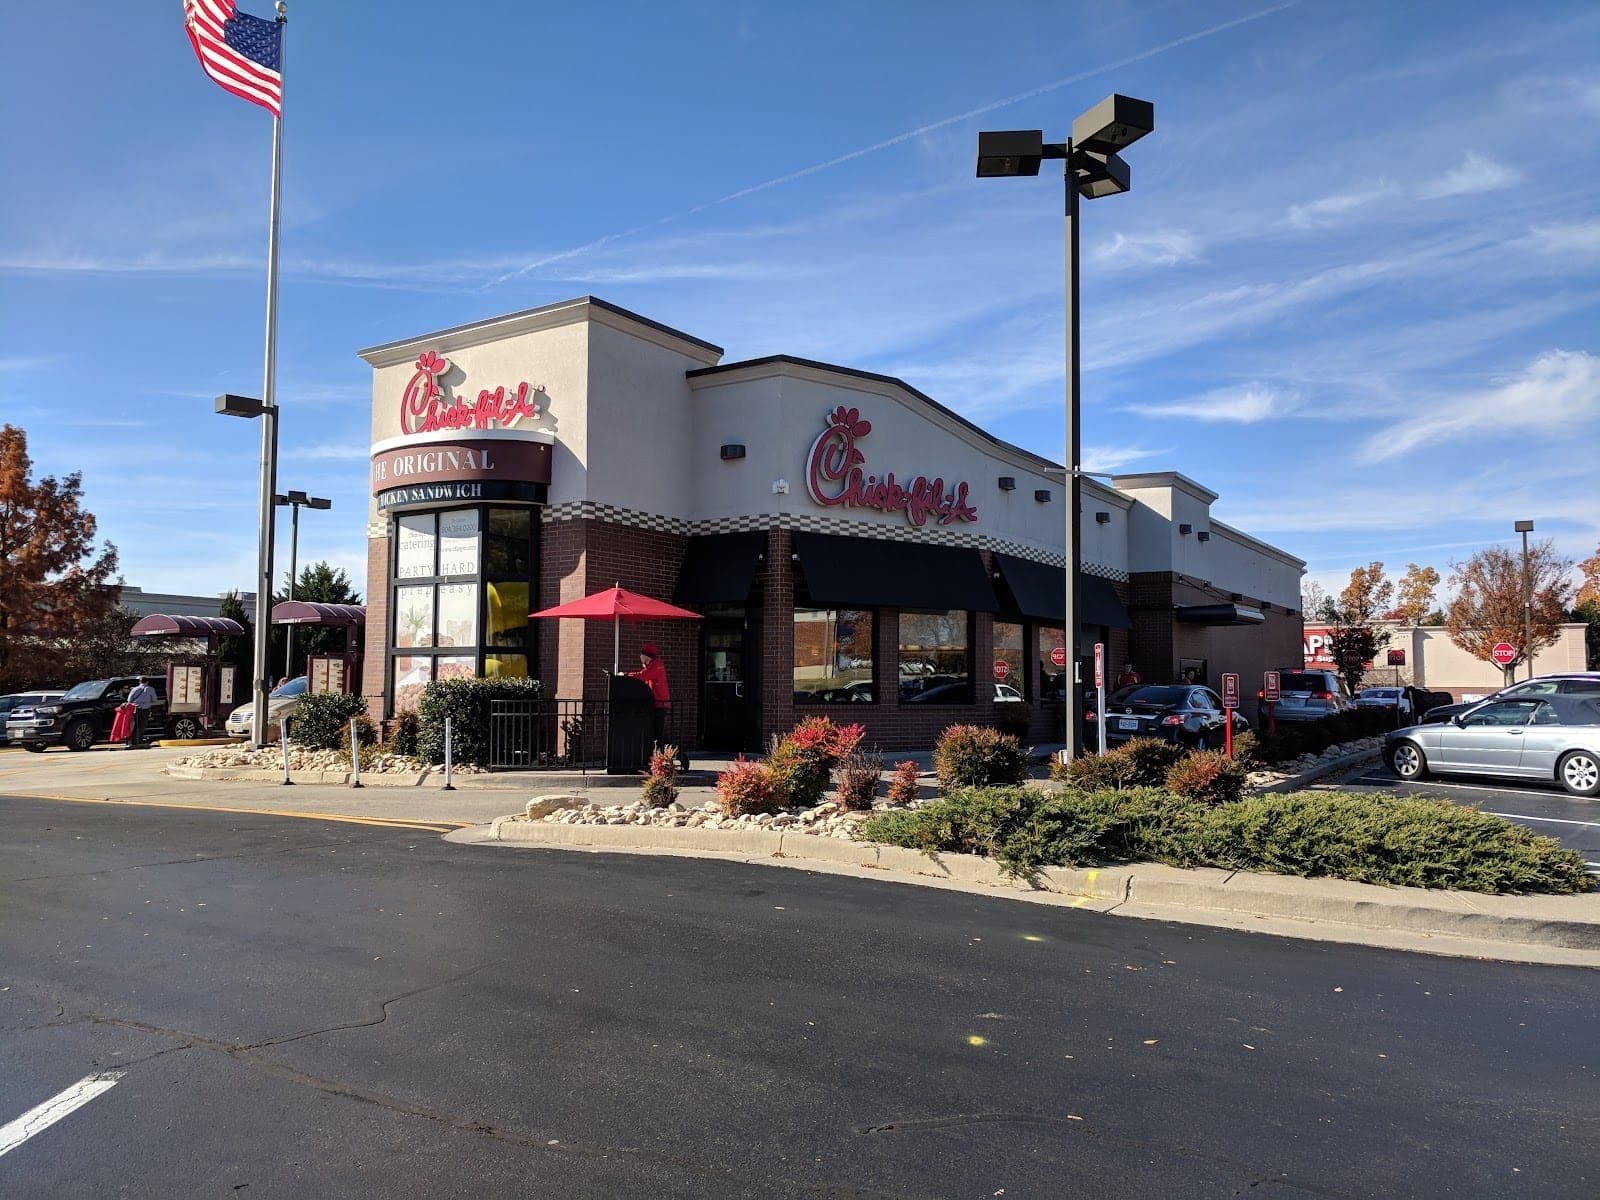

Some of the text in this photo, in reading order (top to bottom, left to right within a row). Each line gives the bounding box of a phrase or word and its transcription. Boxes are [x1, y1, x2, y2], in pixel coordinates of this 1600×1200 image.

[401, 351, 535, 434] Chick-fil-A
[374, 449, 495, 482] HE ORIGINAL
[808, 406, 977, 526] Chick-fil-A
[412, 483, 482, 501] SANDWICH
[400, 561, 475, 576] PARTY HARD
[440, 584, 473, 596] easy
[1494, 649, 1514, 657] STOP
